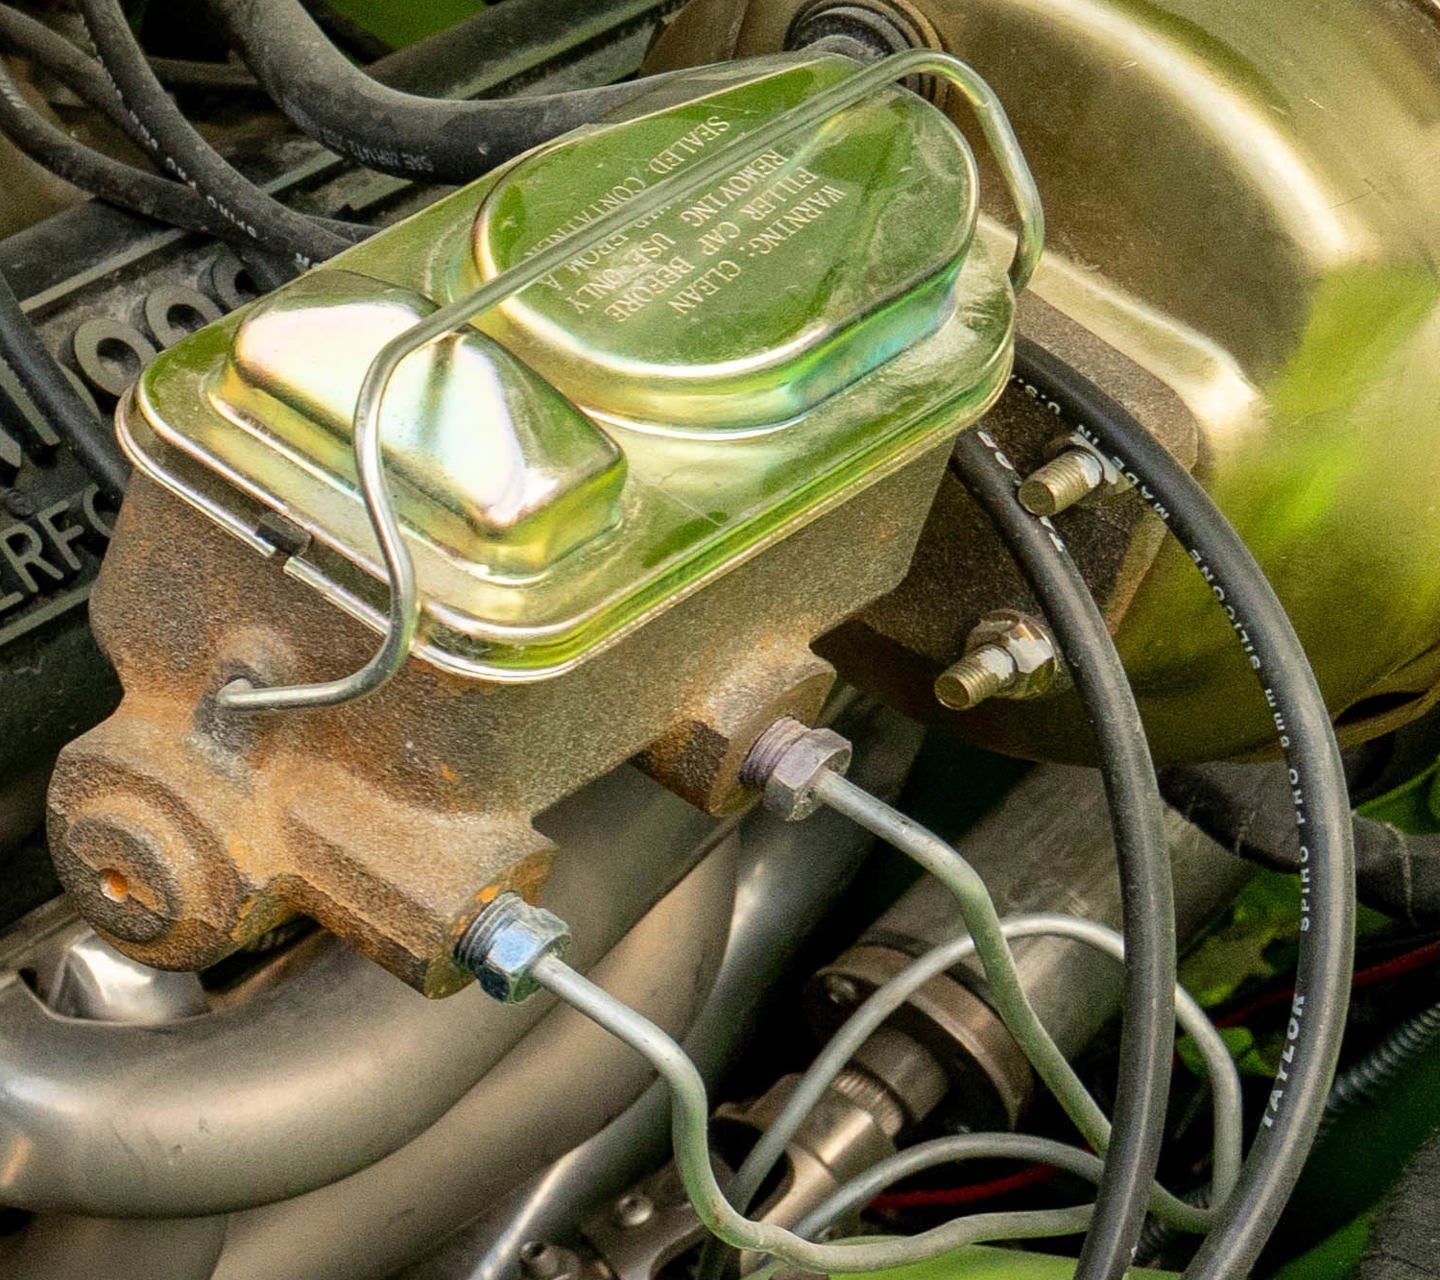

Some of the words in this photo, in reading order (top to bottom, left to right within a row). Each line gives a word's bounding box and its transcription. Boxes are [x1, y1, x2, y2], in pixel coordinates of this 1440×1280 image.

[645, 114, 729, 176] SEALED
[679, 148, 788, 228] REMOVING
[739, 164, 817, 223] FILLER
[628, 231, 675, 267] USE
[695, 220, 740, 258] CAP
[737, 183, 845, 261] WARNING:
[564, 266, 624, 313] ONLY
[602, 254, 694, 323] BEFORE
[666, 258, 740, 317] CLEAN
[1073, 419, 1101, 448] IN
[1109, 451, 1171, 522] MADE
[1189, 547, 1262, 669] SILICONE
[1288, 768, 1305, 823] PRO
[1299, 845, 1310, 931] SPIRO
[1262, 993, 1306, 1129] TAYLOR
